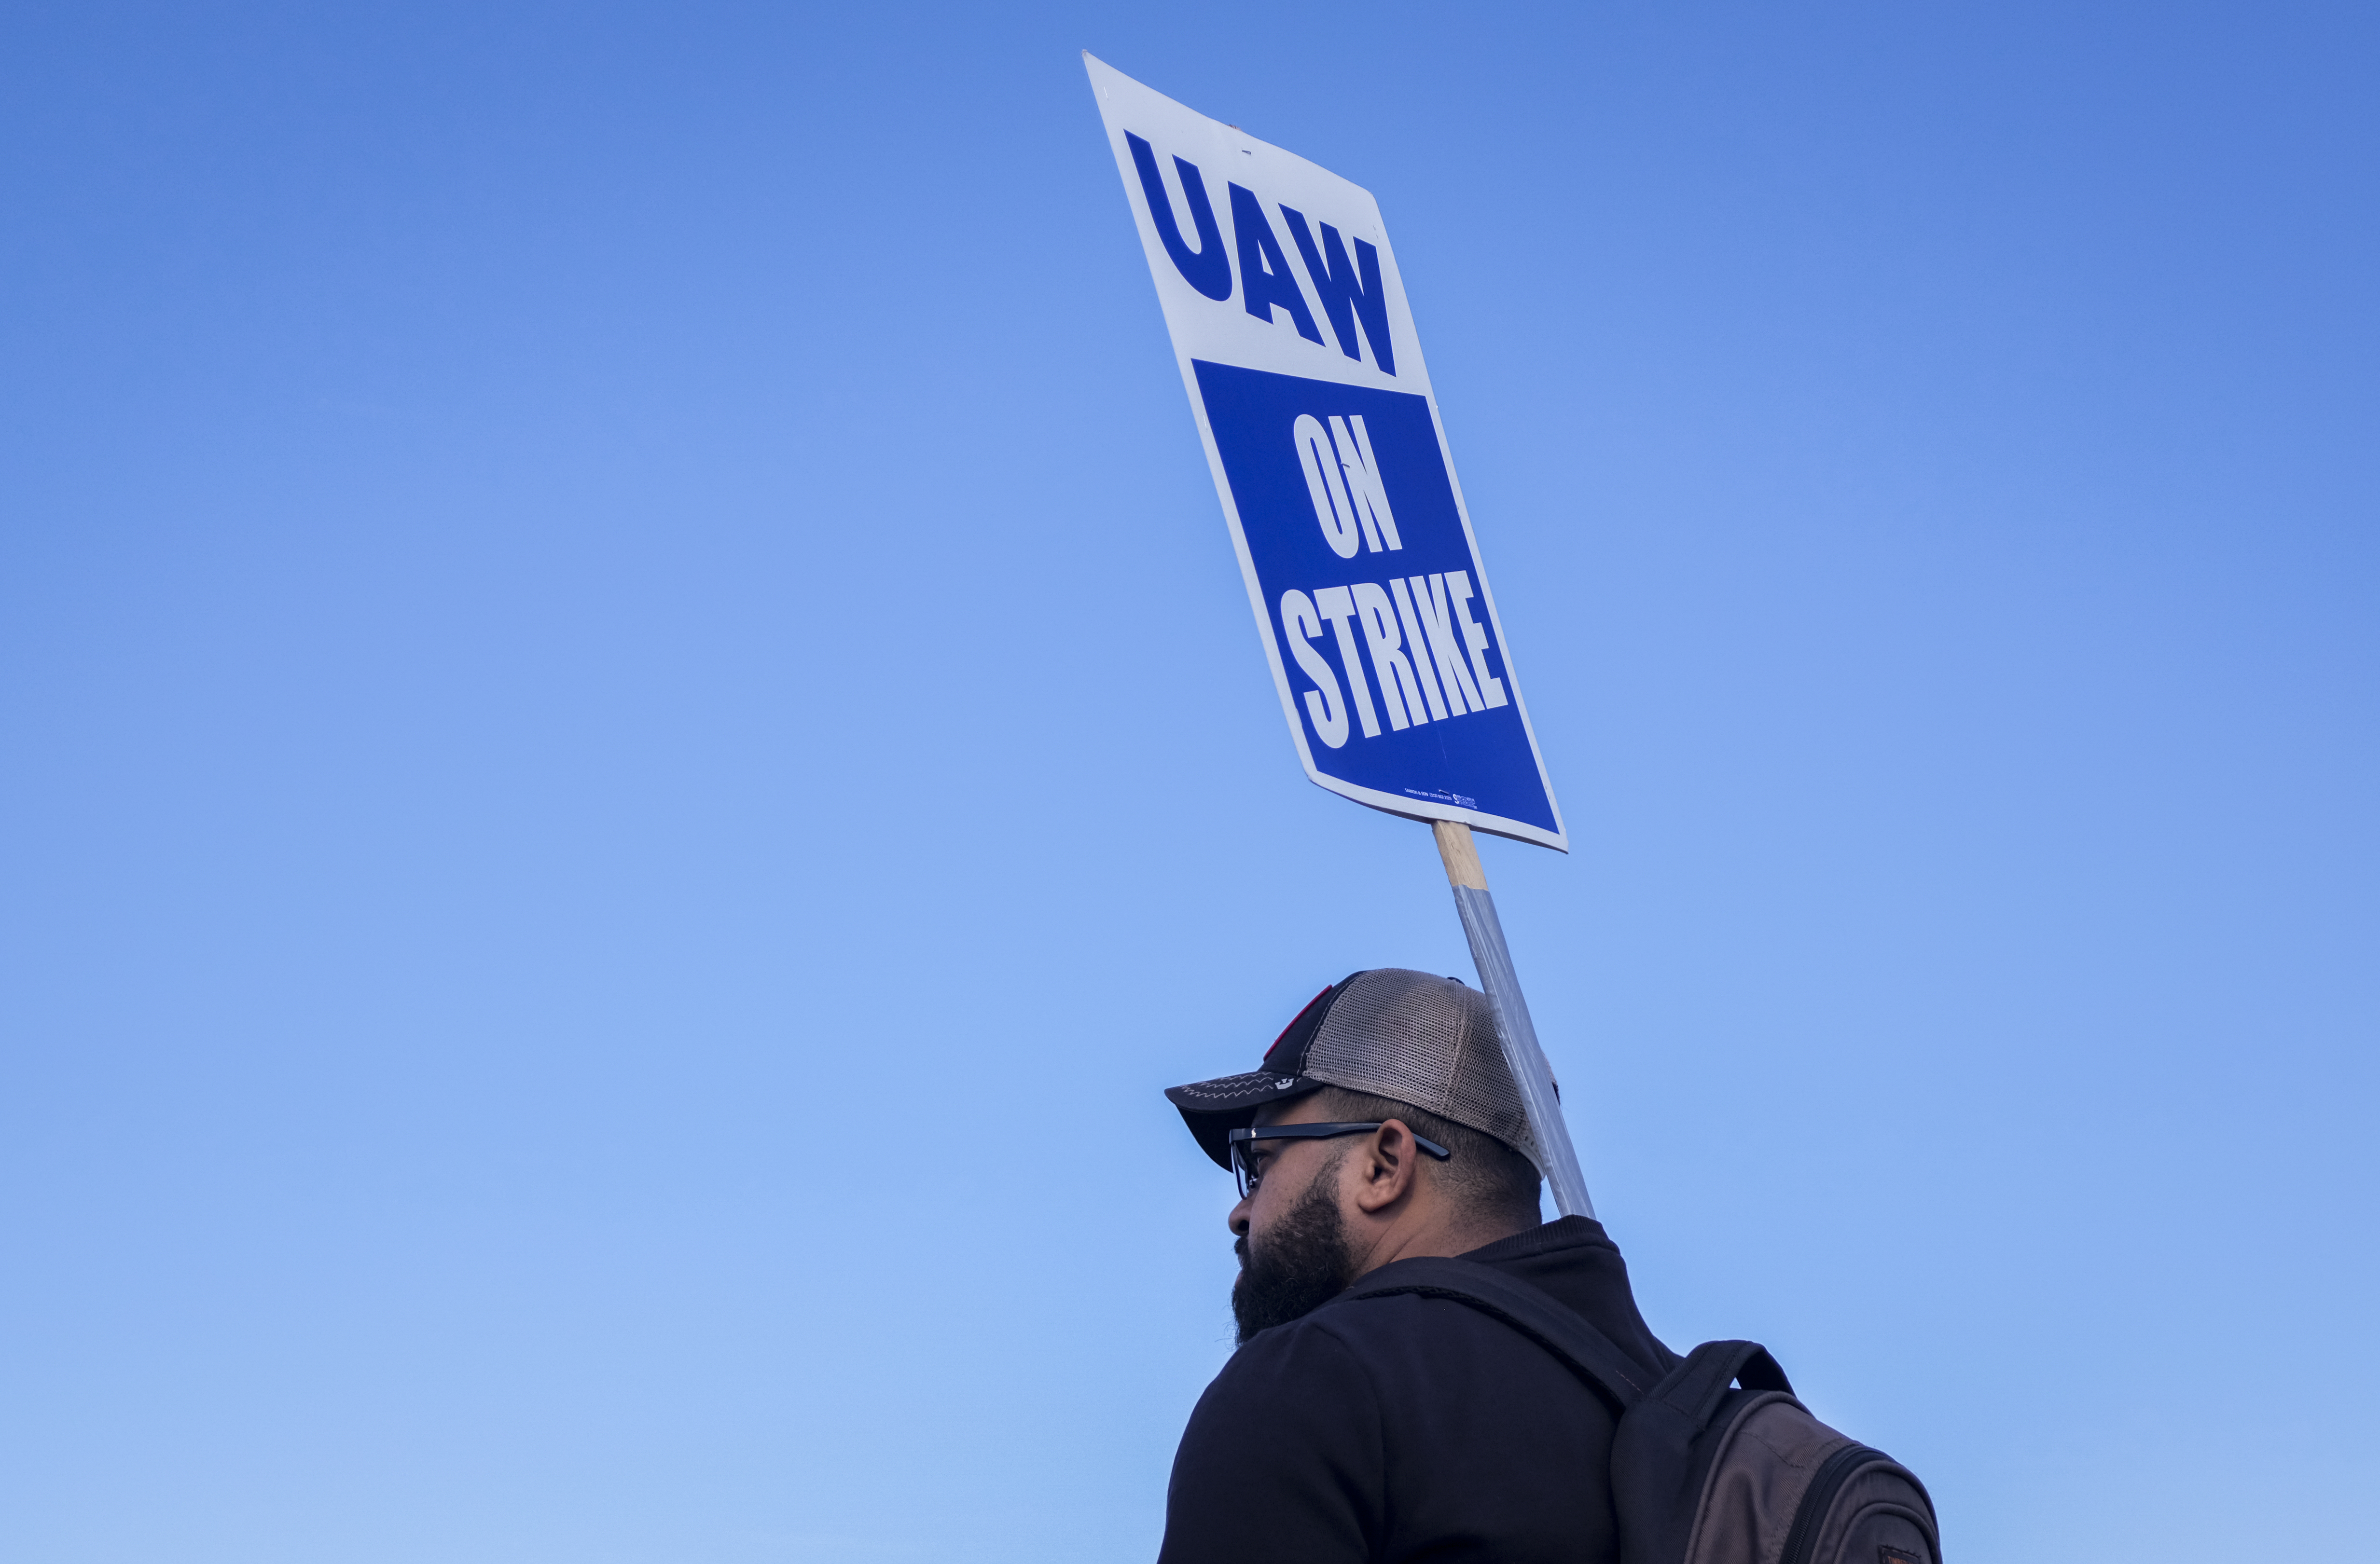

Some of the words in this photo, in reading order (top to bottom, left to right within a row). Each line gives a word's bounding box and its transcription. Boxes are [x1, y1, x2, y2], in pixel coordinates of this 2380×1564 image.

[1124, 130, 1396, 377] UAW
[1294, 414, 1403, 558] ON
[1281, 570, 1508, 749] STRIKE
